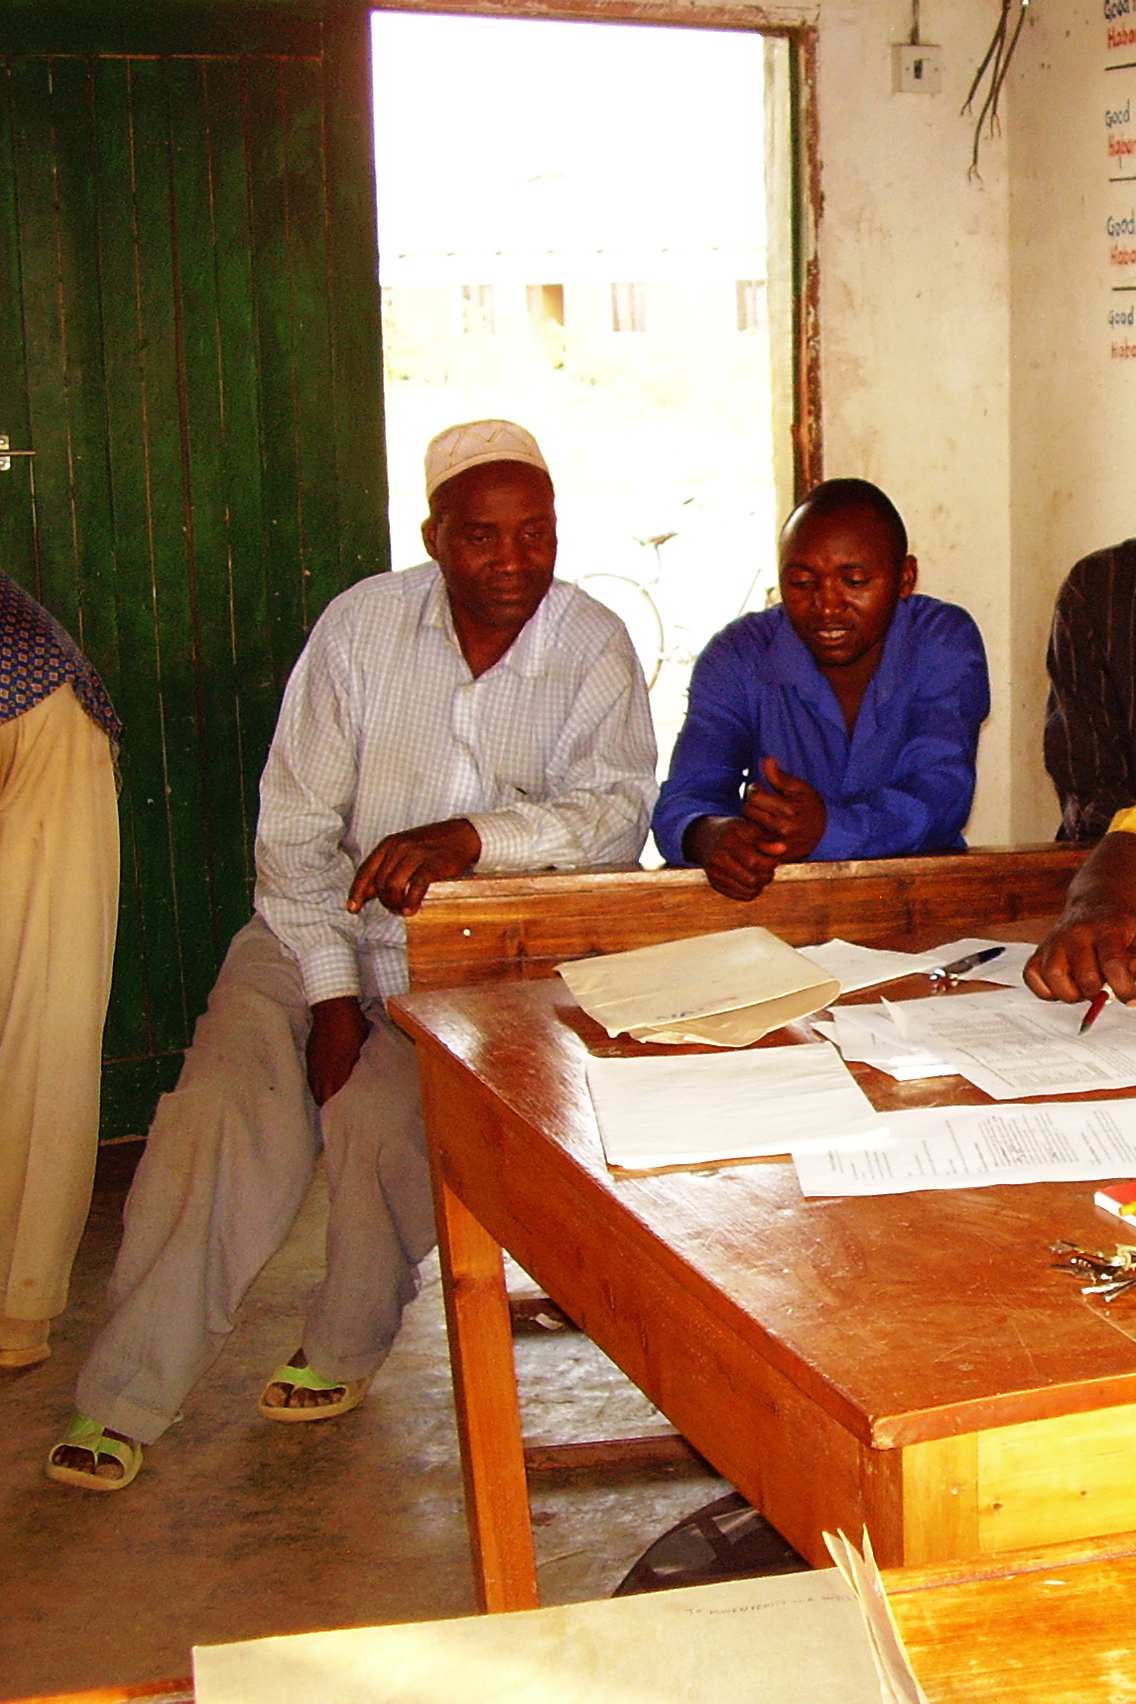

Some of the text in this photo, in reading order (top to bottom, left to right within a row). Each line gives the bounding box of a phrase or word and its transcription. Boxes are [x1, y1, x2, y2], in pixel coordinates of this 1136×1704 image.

[1104, 97, 1130, 128] Good
[1106, 210, 1136, 236] Good
[1108, 305, 1135, 329] Good
